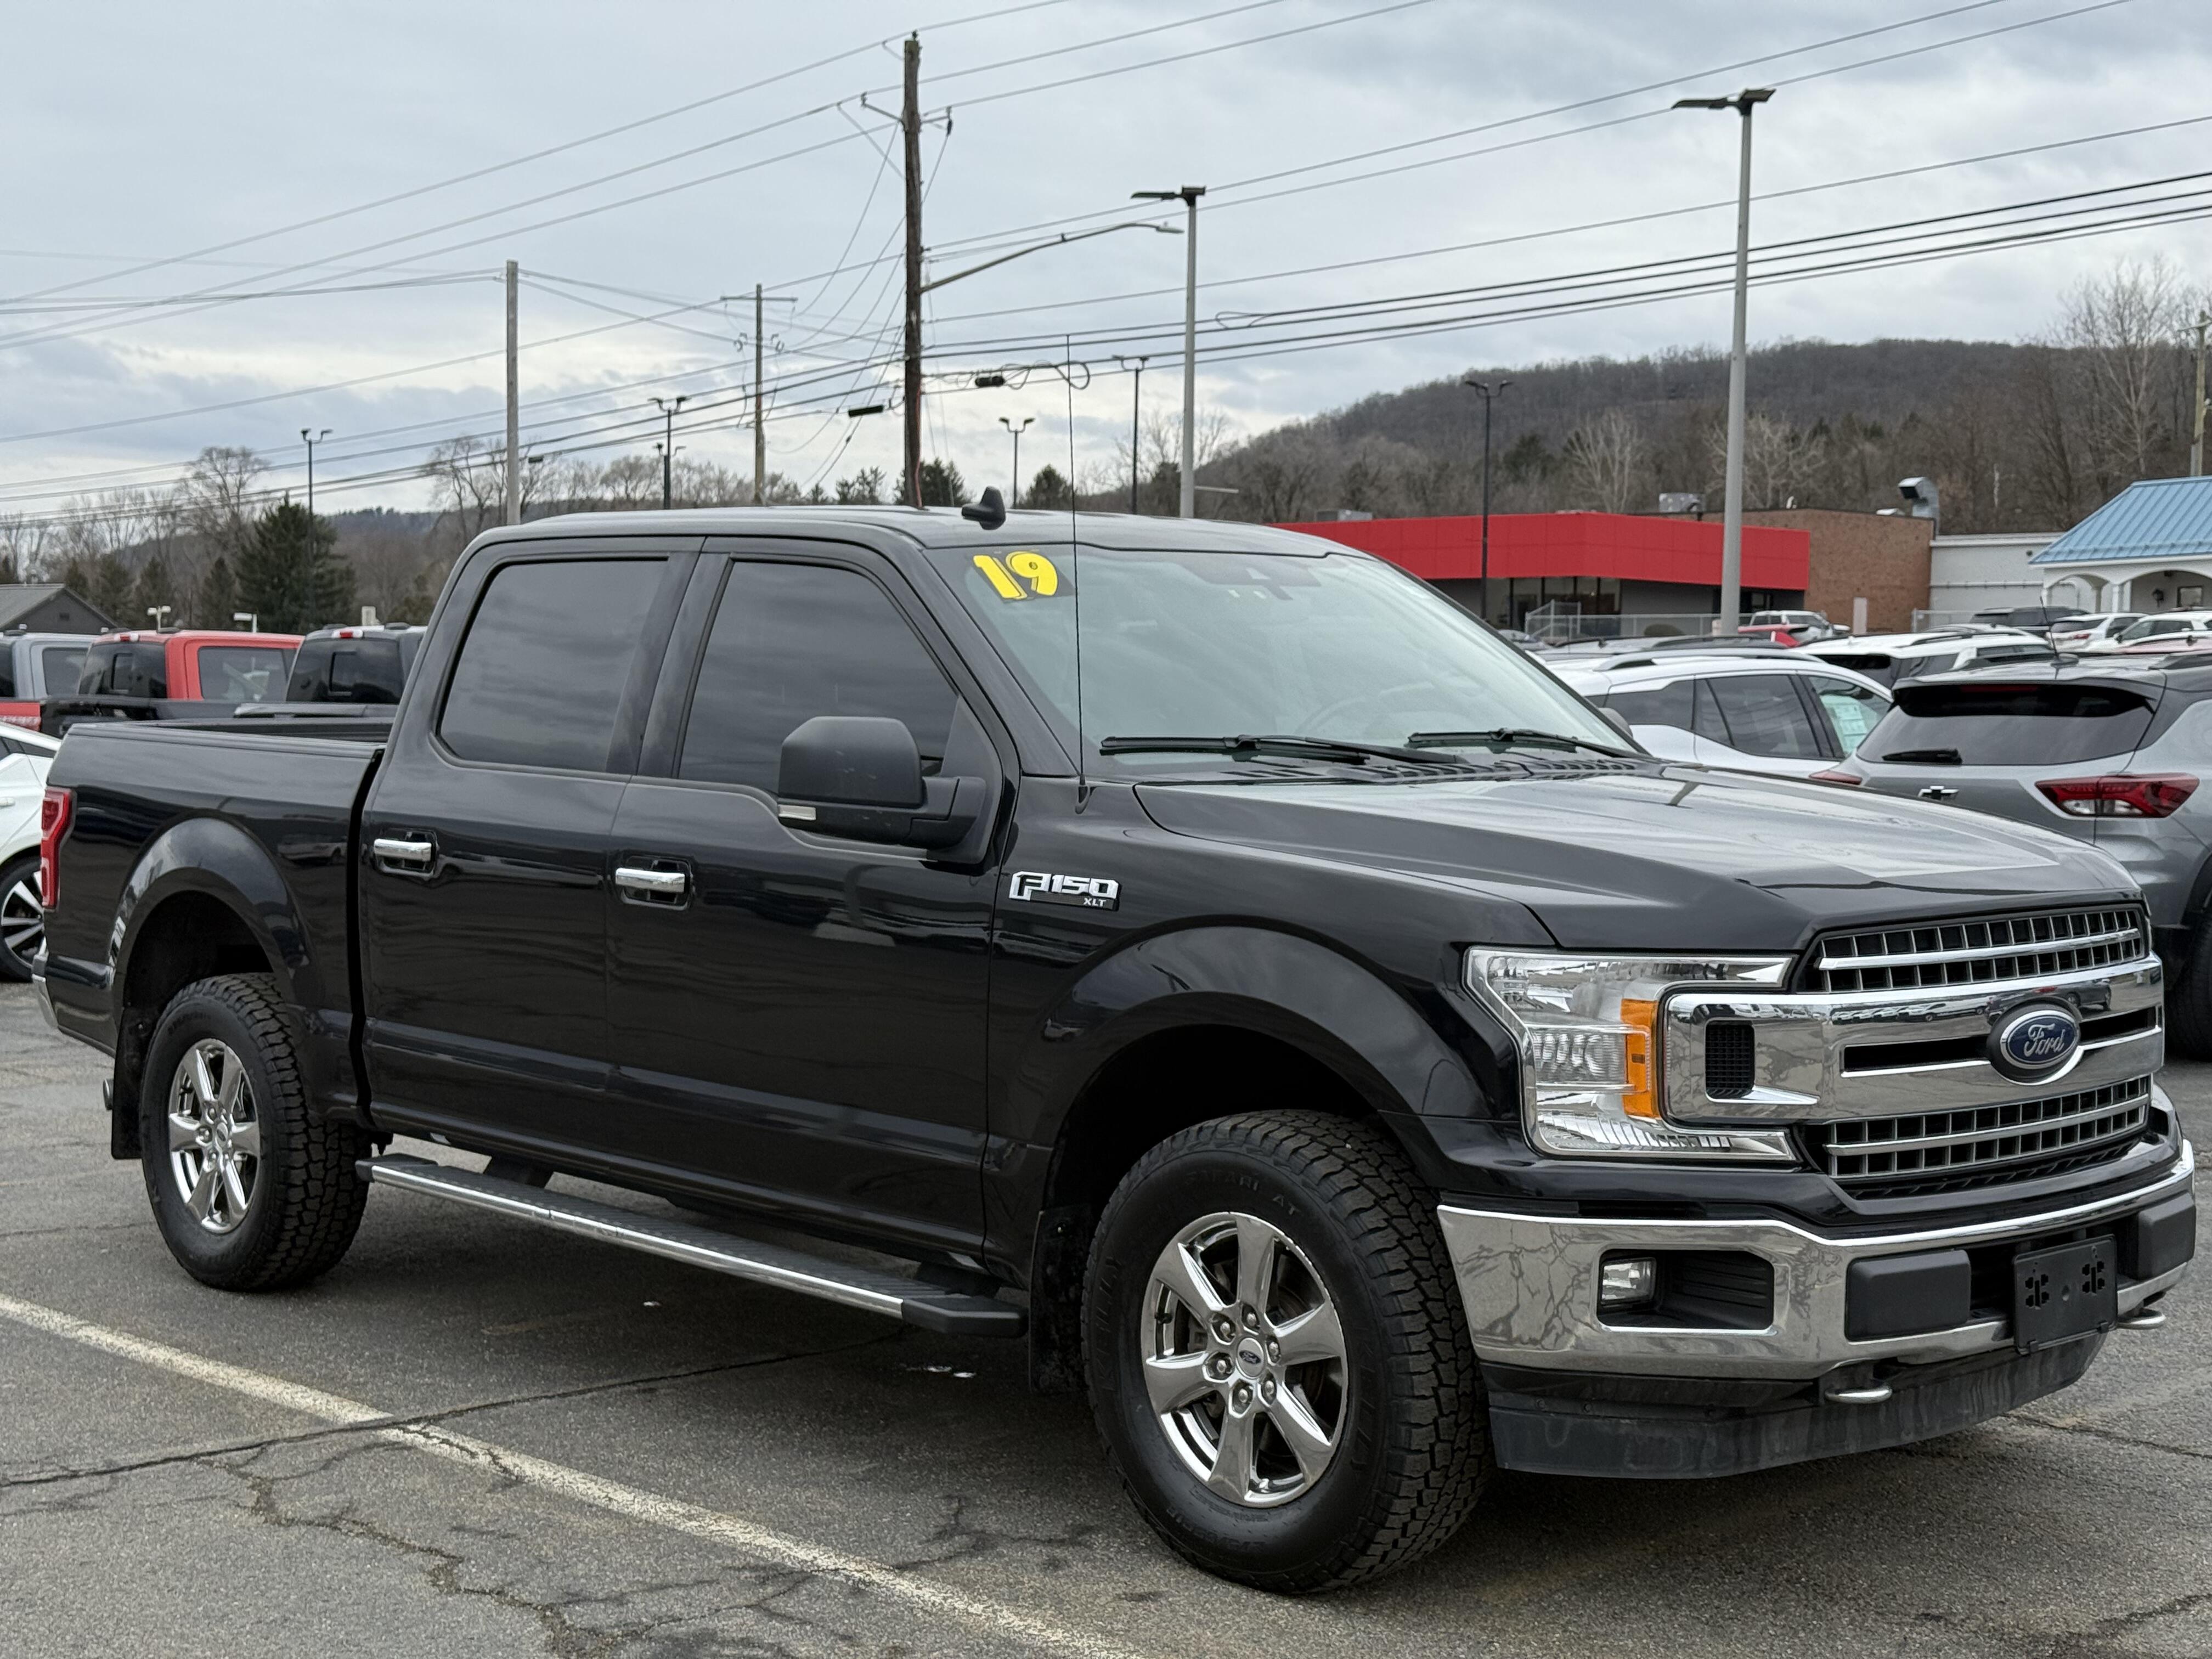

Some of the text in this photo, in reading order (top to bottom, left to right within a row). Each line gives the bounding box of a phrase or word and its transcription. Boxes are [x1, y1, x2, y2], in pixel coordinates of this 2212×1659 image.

[973, 550, 1058, 600] 19
[1083, 897, 1107, 907] XLT
[2023, 1023, 2066, 1057] Ford
[1272, 1193, 1302, 1216] AT
